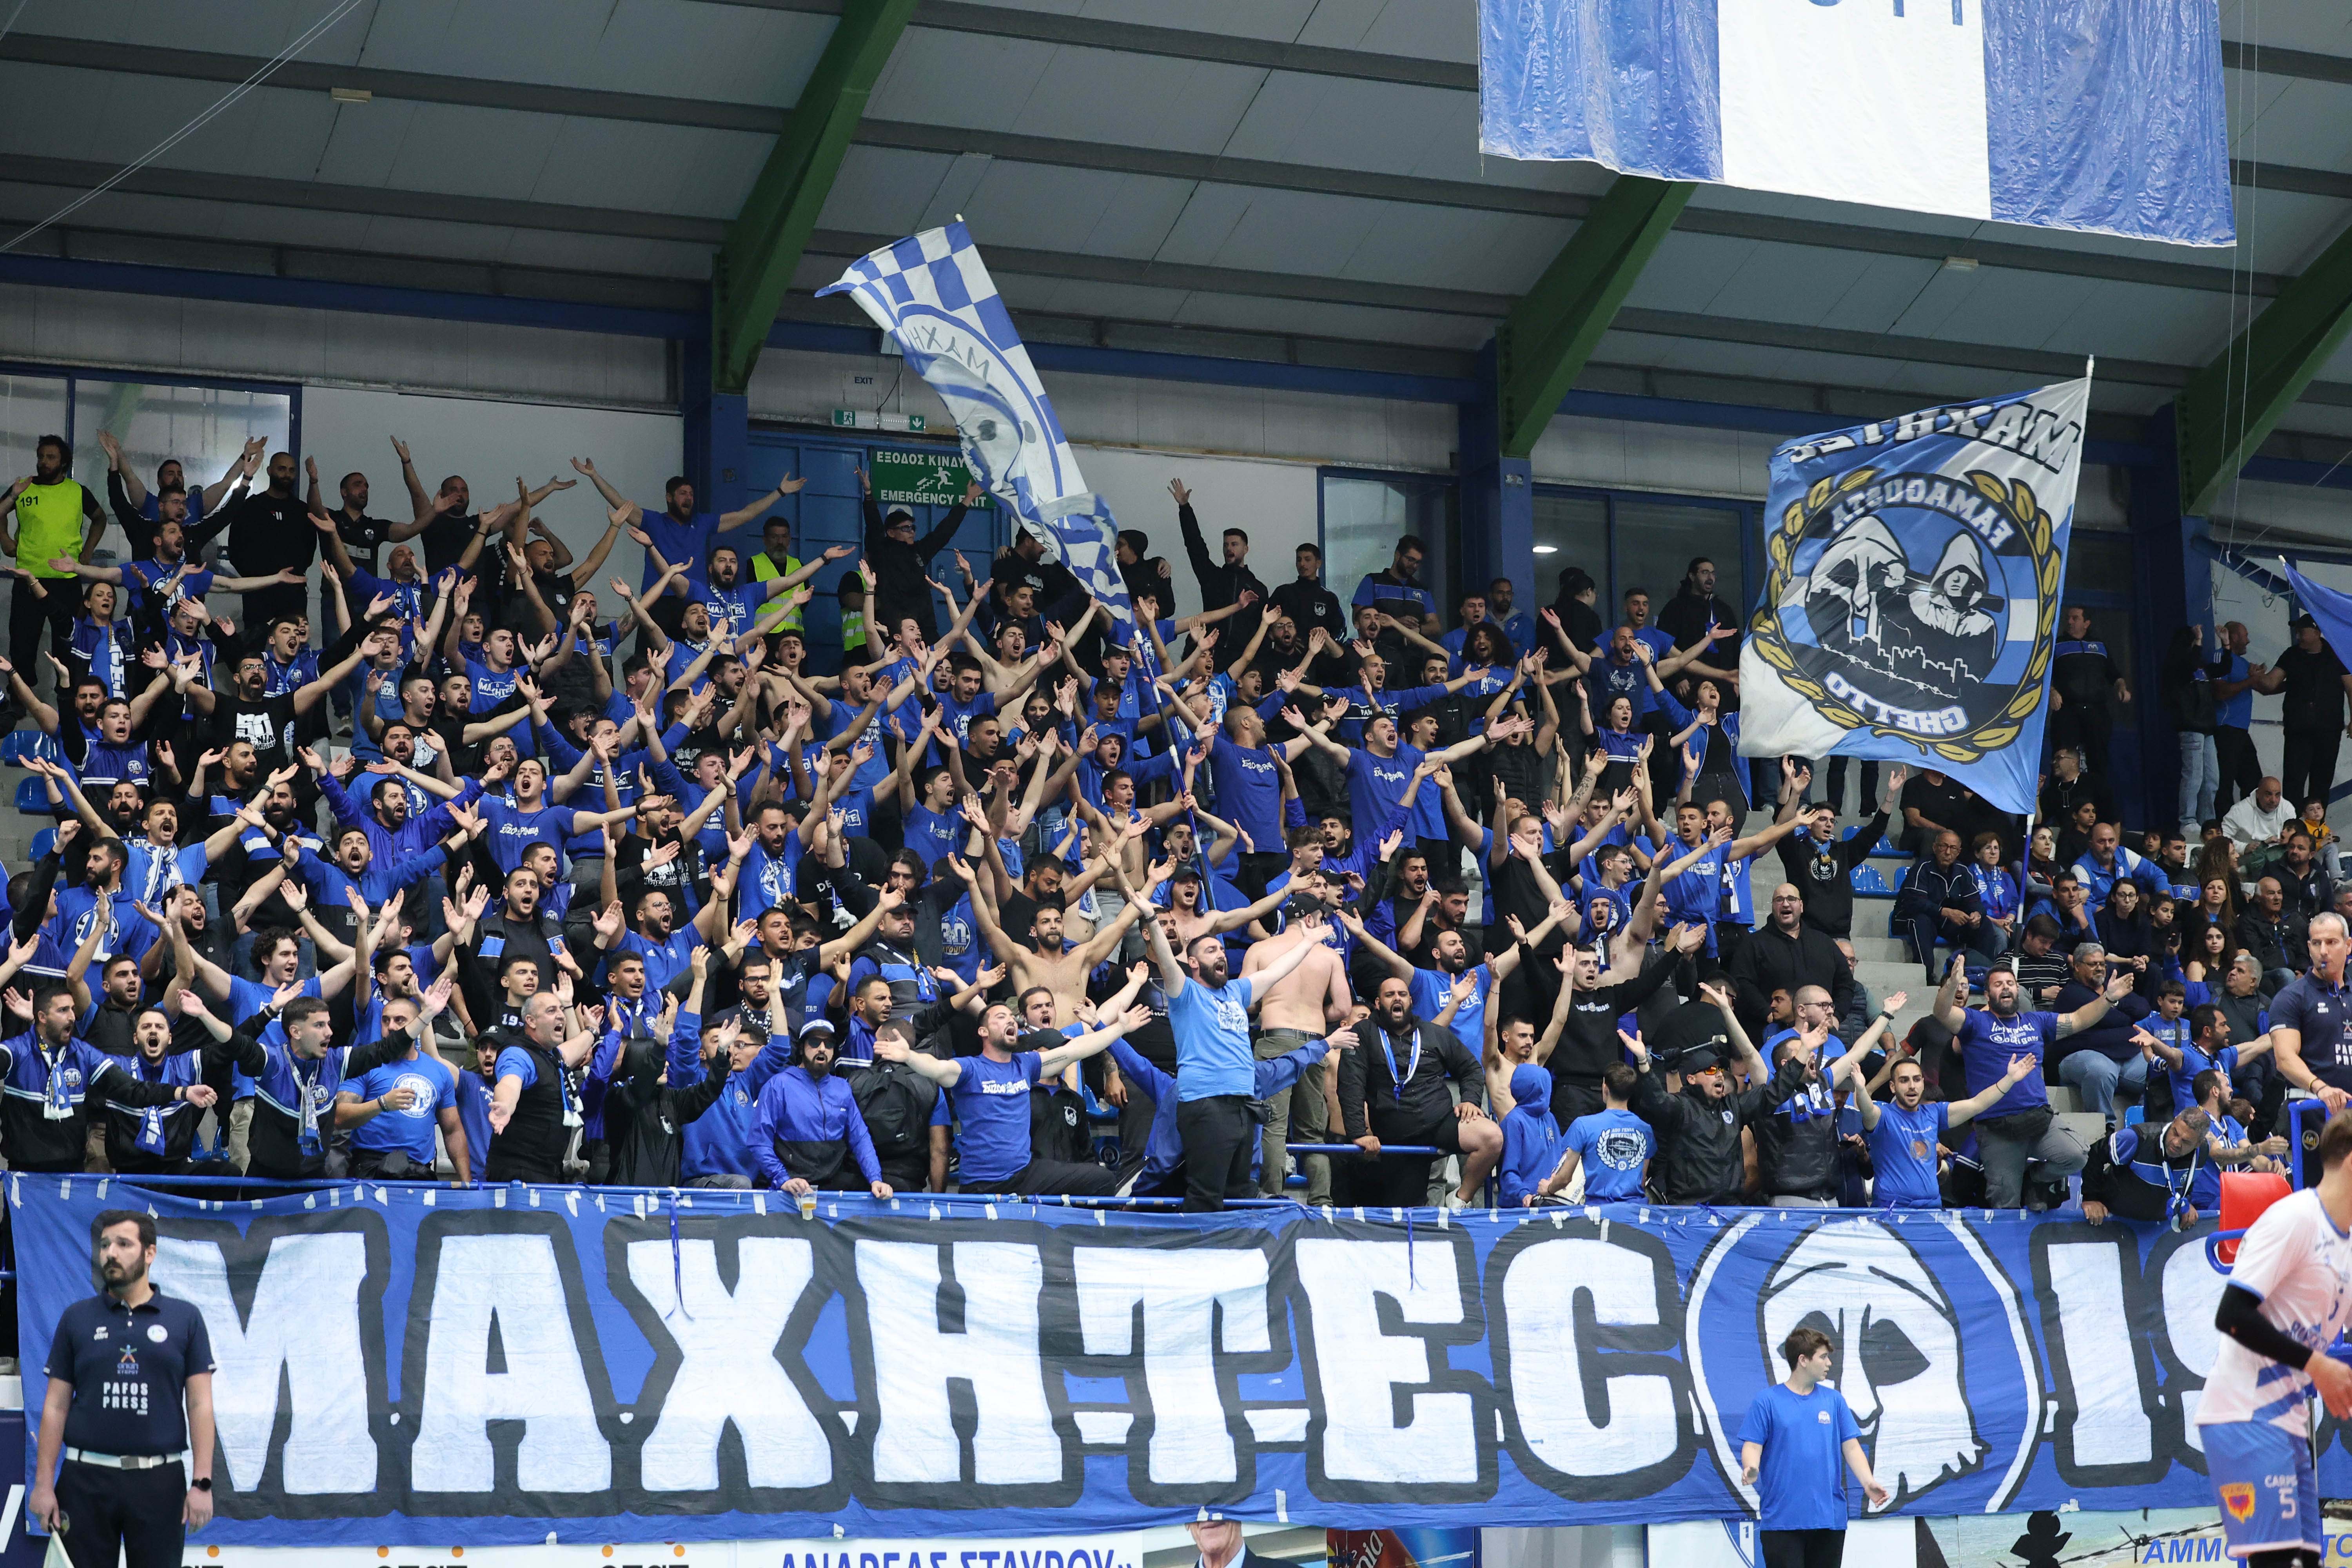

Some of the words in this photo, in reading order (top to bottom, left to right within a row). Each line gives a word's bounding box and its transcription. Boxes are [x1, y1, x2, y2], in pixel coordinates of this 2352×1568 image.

[855, 376, 874, 385] EXIT
[877, 451, 924, 465] ΕΞΟΔΟΣ
[928, 454, 965, 468] ΚΙΝΔΥ
[20, 496, 38, 508] 191
[881, 489, 953, 505] EMERGENCY
[236, 713, 274, 738] 50
[103, 1382, 148, 1397] PAFOS
[103, 1396, 148, 1411] PRESS
[2279, 1488, 2296, 1519] 5
